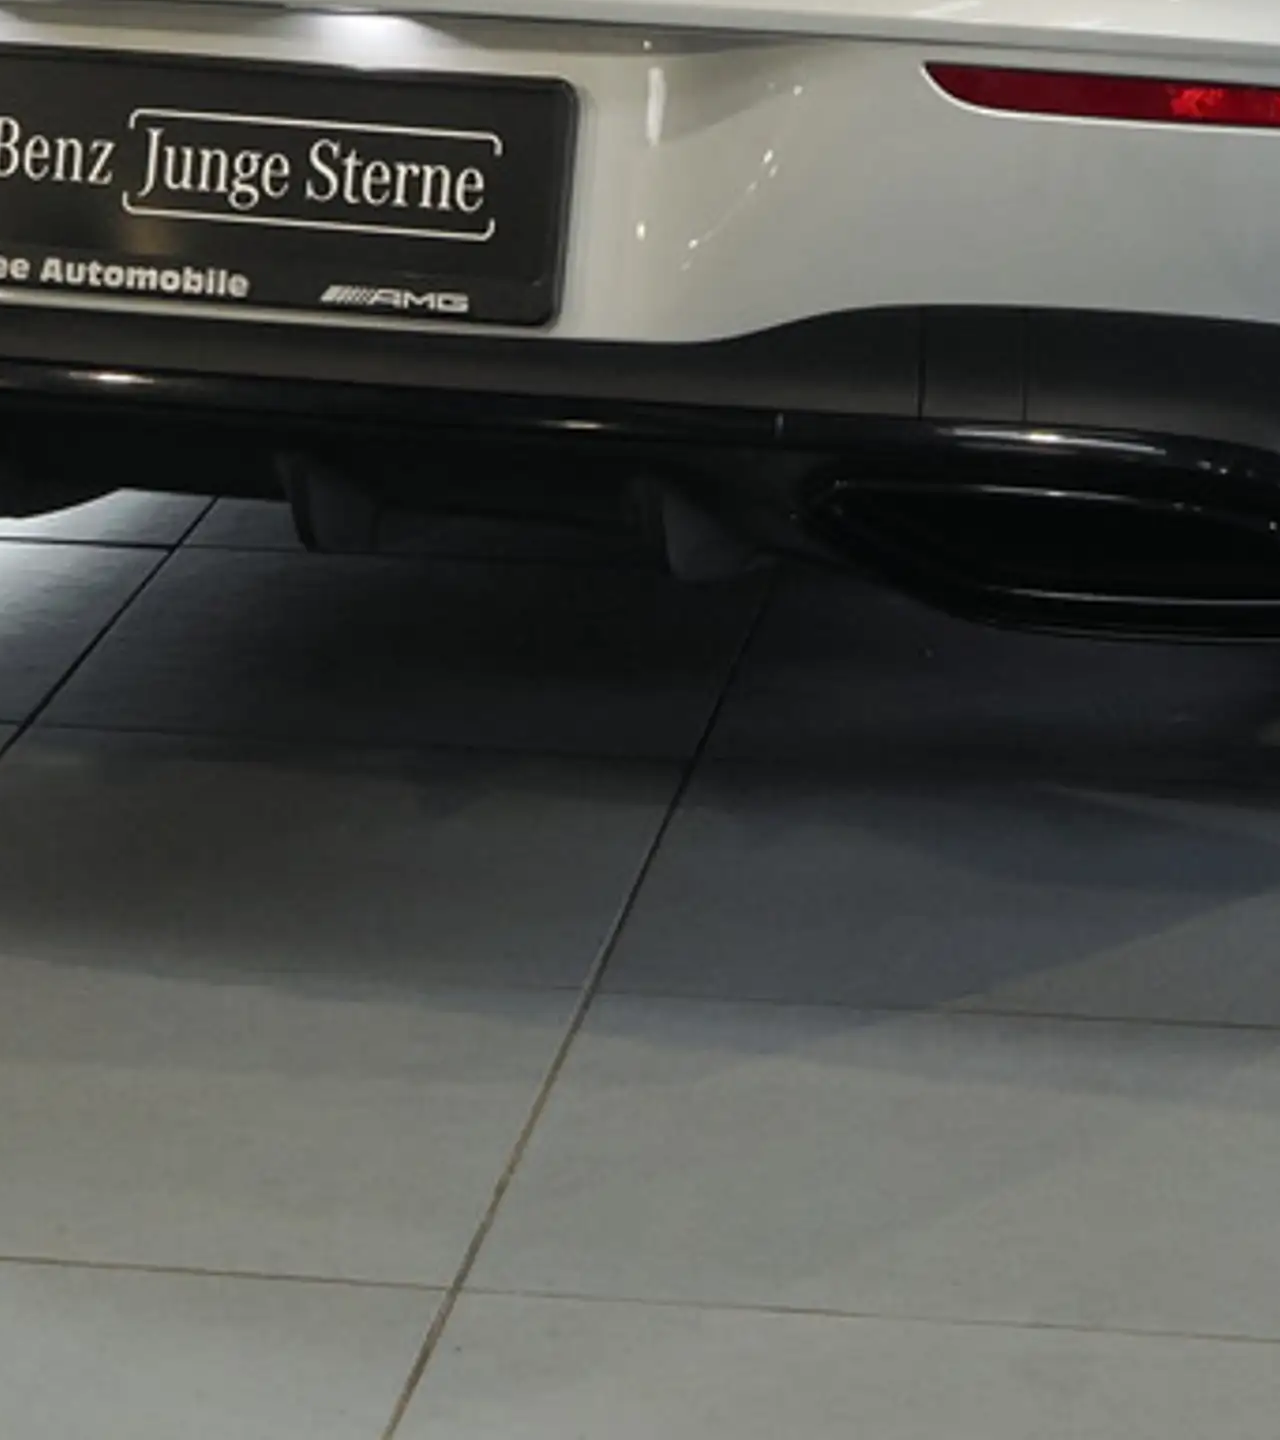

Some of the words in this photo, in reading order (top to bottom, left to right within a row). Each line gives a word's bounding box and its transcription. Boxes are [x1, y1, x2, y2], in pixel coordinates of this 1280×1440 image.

[136, 127, 292, 210] Junge
[304, 137, 485, 213] Sterne
[39, 256, 250, 299] Automobile
[368, 287, 470, 313] AMG
